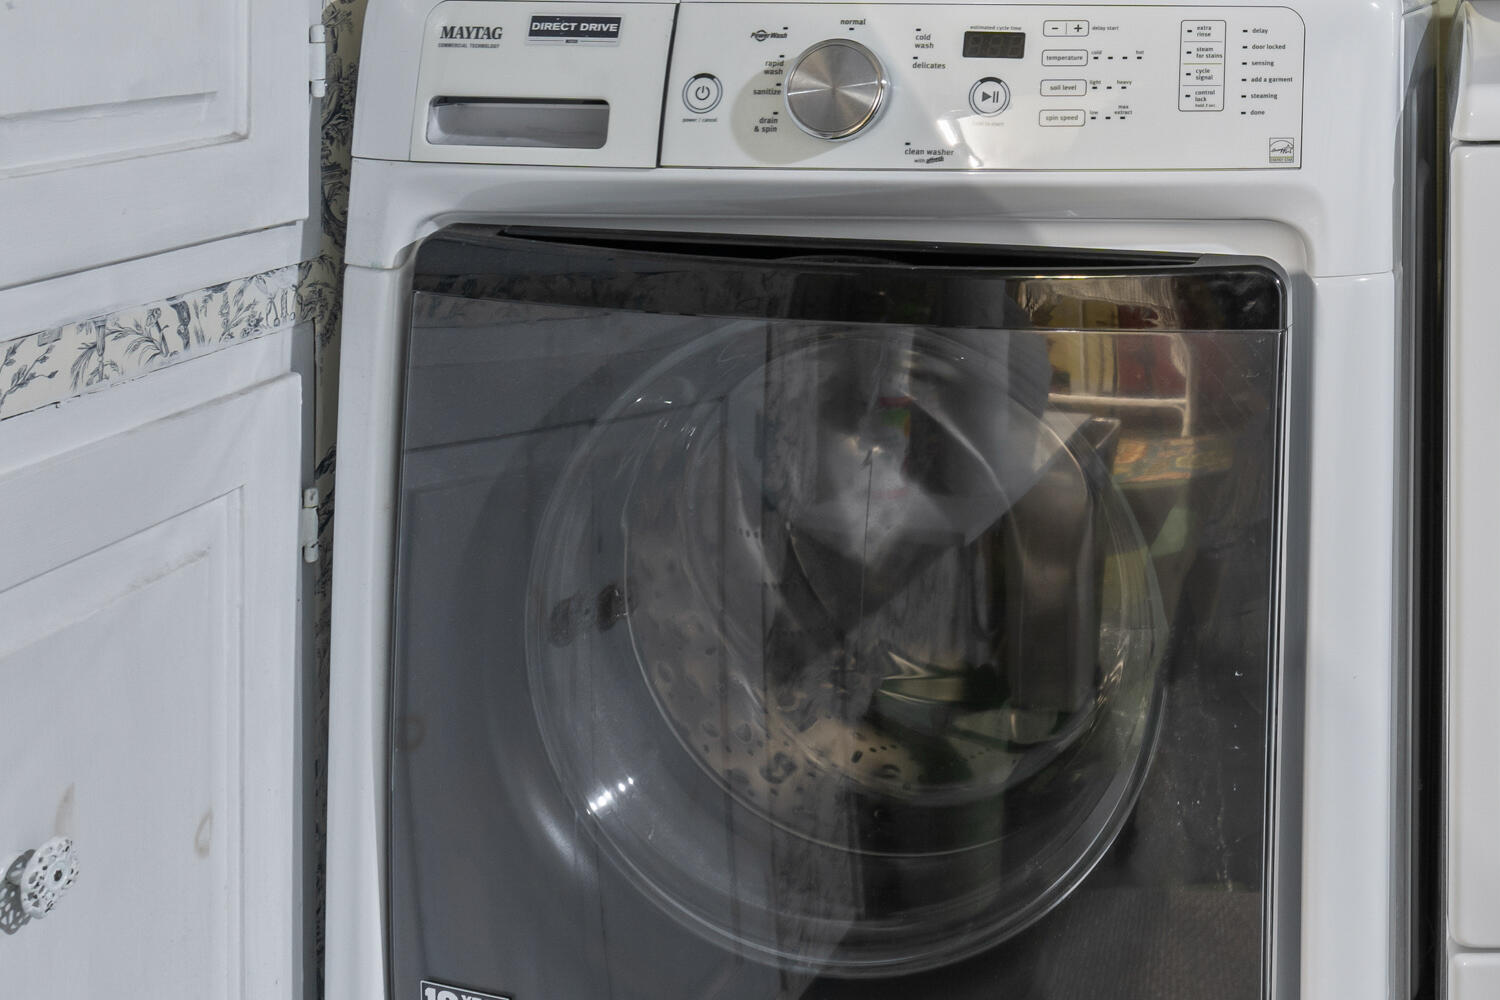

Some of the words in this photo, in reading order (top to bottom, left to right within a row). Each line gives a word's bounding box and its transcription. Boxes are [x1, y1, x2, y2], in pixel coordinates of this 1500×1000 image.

[840, 18, 866, 26] normal
[531, 22, 578, 31] DIRECT
[580, 23, 619, 32] DRIVE
[1251, 27, 1269, 35] delay
[440, 26, 503, 40] MAYTAG
[1046, 55, 1083, 63] temperature
[764, 60, 785, 68] rapid
[912, 61, 946, 70] delicates
[1268, 76, 1293, 84] garment
[1049, 83, 1061, 91] soil
[1062, 83, 1077, 91] level
[752, 88, 782, 96] sanitize
[759, 117, 779, 125] drain
[761, 126, 778, 134] spin
[904, 147, 925, 155] clean
[926, 148, 954, 156] washer
